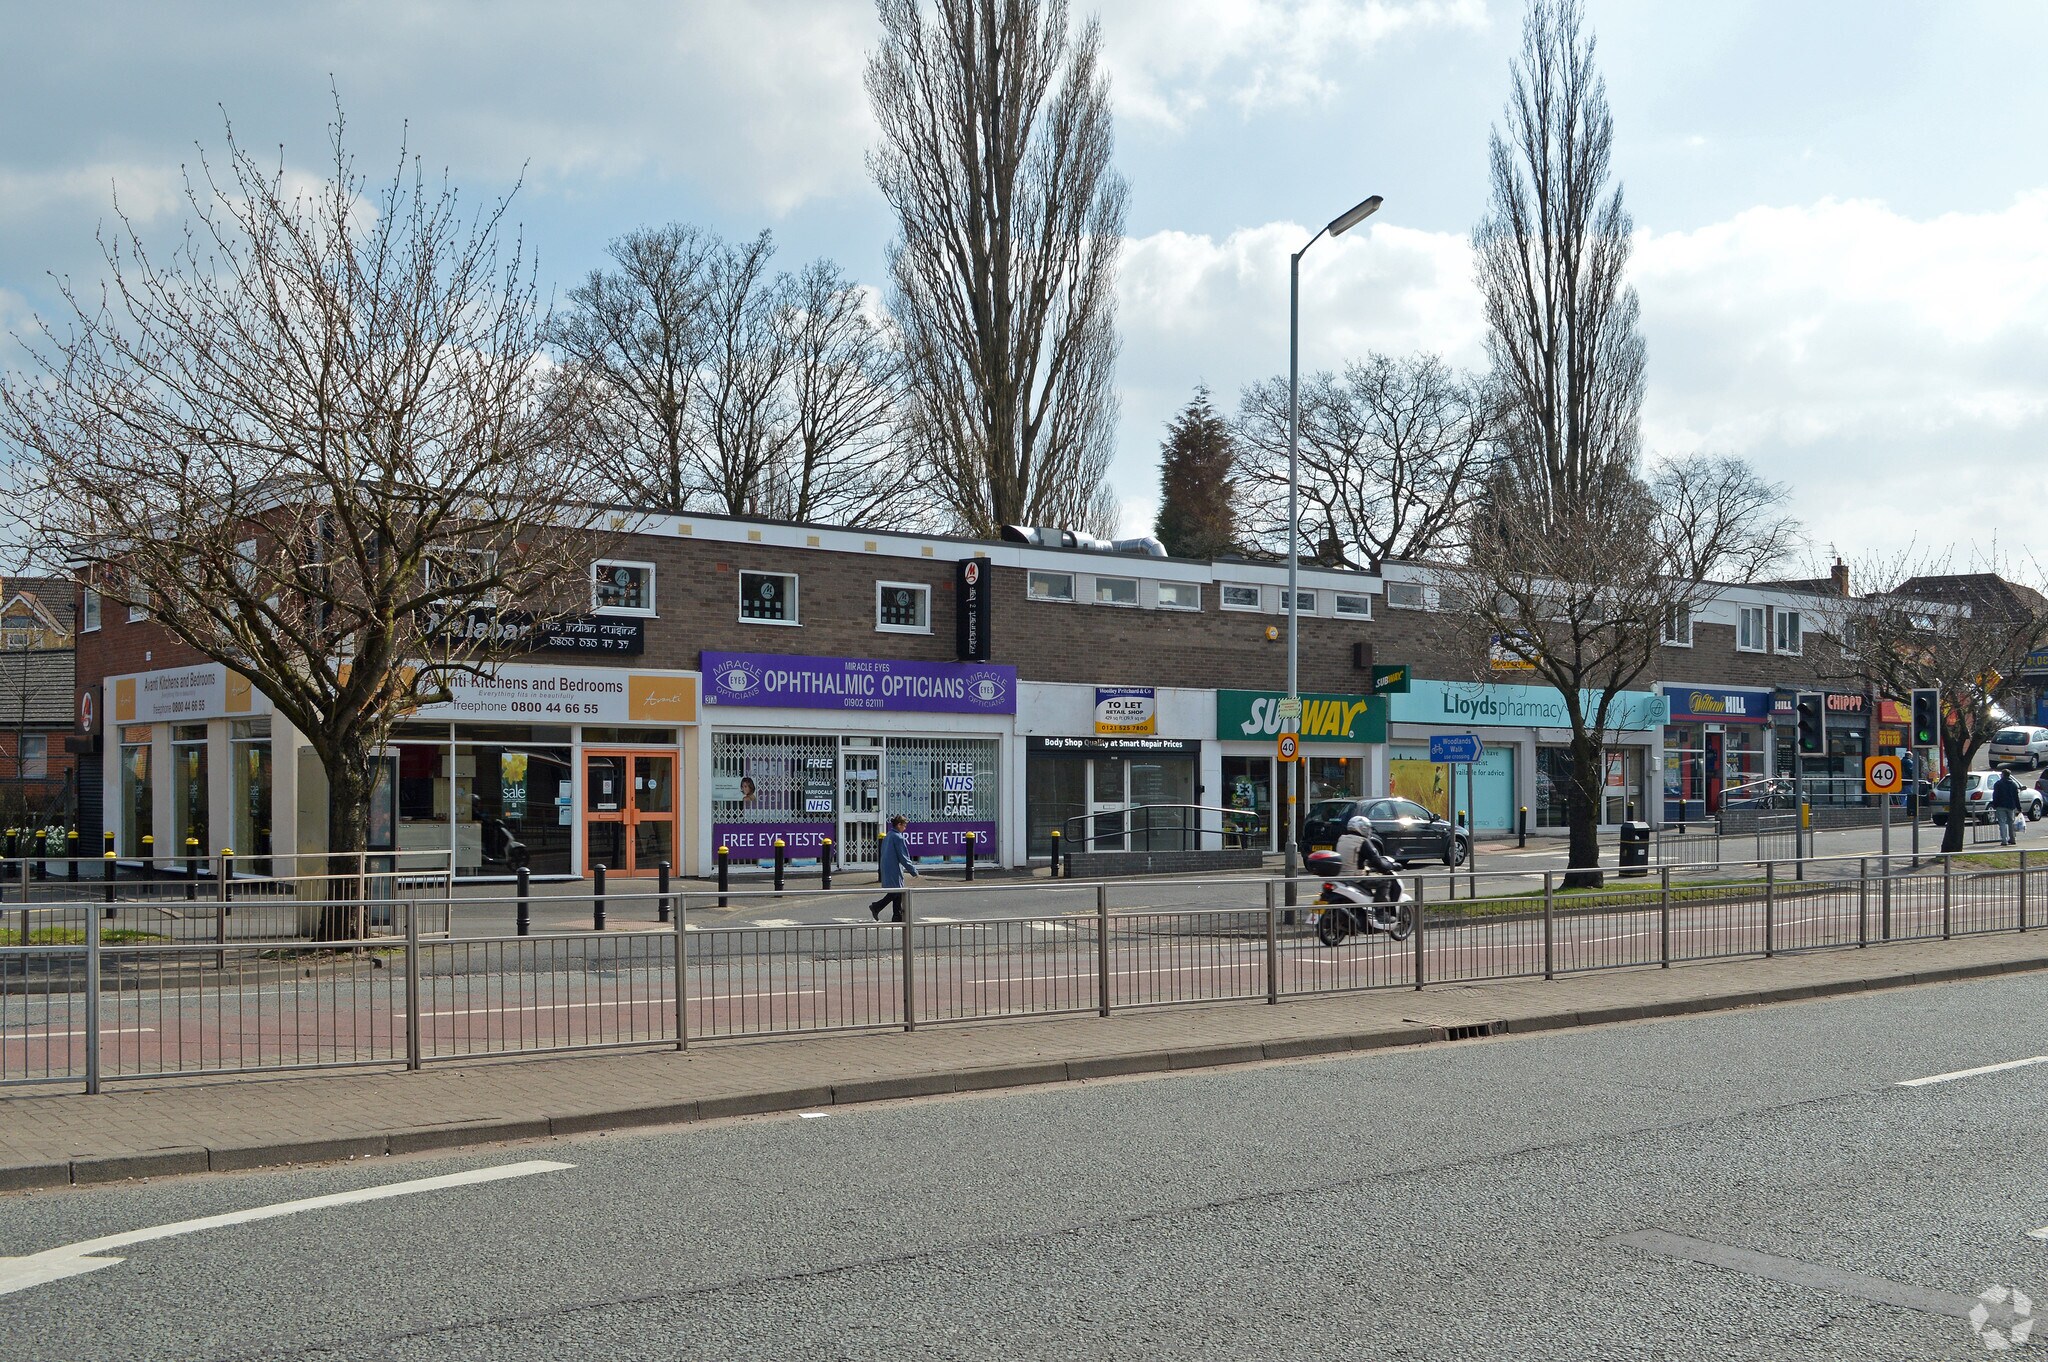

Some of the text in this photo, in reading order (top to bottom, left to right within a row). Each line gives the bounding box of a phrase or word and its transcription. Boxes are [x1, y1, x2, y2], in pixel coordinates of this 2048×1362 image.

[565, 618, 596, 633] indian
[600, 622, 637, 637] cuisine
[549, 636, 575, 647] 0800
[579, 637, 598, 648] 030
[712, 660, 762, 678] MIRACLE
[845, 662, 890, 672] MIRACLE EYES
[190, 672, 215, 687] Bedrooms
[471, 674, 528, 690] Kitchens
[532, 677, 555, 691] and
[560, 678, 623, 693] Bedrooms
[730, 676, 745, 685] EYES
[764, 669, 964, 699] OPHTHALMIC OPTICIANS
[966, 671, 1008, 688] MIRACLE
[1375, 671, 1403, 688] SUBWAY
[479, 690, 515, 698] Everything
[540, 692, 574, 700] beautifully
[716, 686, 760, 700] OPTICIANS
[980, 686, 993, 695] EYES
[184, 700, 190, 711] 44
[453, 700, 598, 714] freephone 0800 44 66 55
[844, 698, 863, 707] 01902
[968, 695, 1006, 708] OPTICIANS
[1689, 691, 1746, 714] William HILL
[1775, 701, 1792, 709] HILL
[1045, 739, 1063, 747] Body
[1065, 739, 1082, 747] Shop
[1084, 739, 1109, 749] Quality
[1141, 740, 1162, 749] Repair
[1283, 743, 1294, 752] 40
[807, 759, 833, 768] FREE
[945, 763, 973, 773] FREE
[1874, 769, 1893, 780] 40
[944, 777, 973, 790] NHS
[503, 784, 526, 799] sale
[808, 801, 830, 811] NHS
[944, 806, 973, 816] CARE
[723, 833, 754, 847] FREE
[786, 833, 825, 846] TESTS
[902, 831, 987, 844] REE EYE TETS
